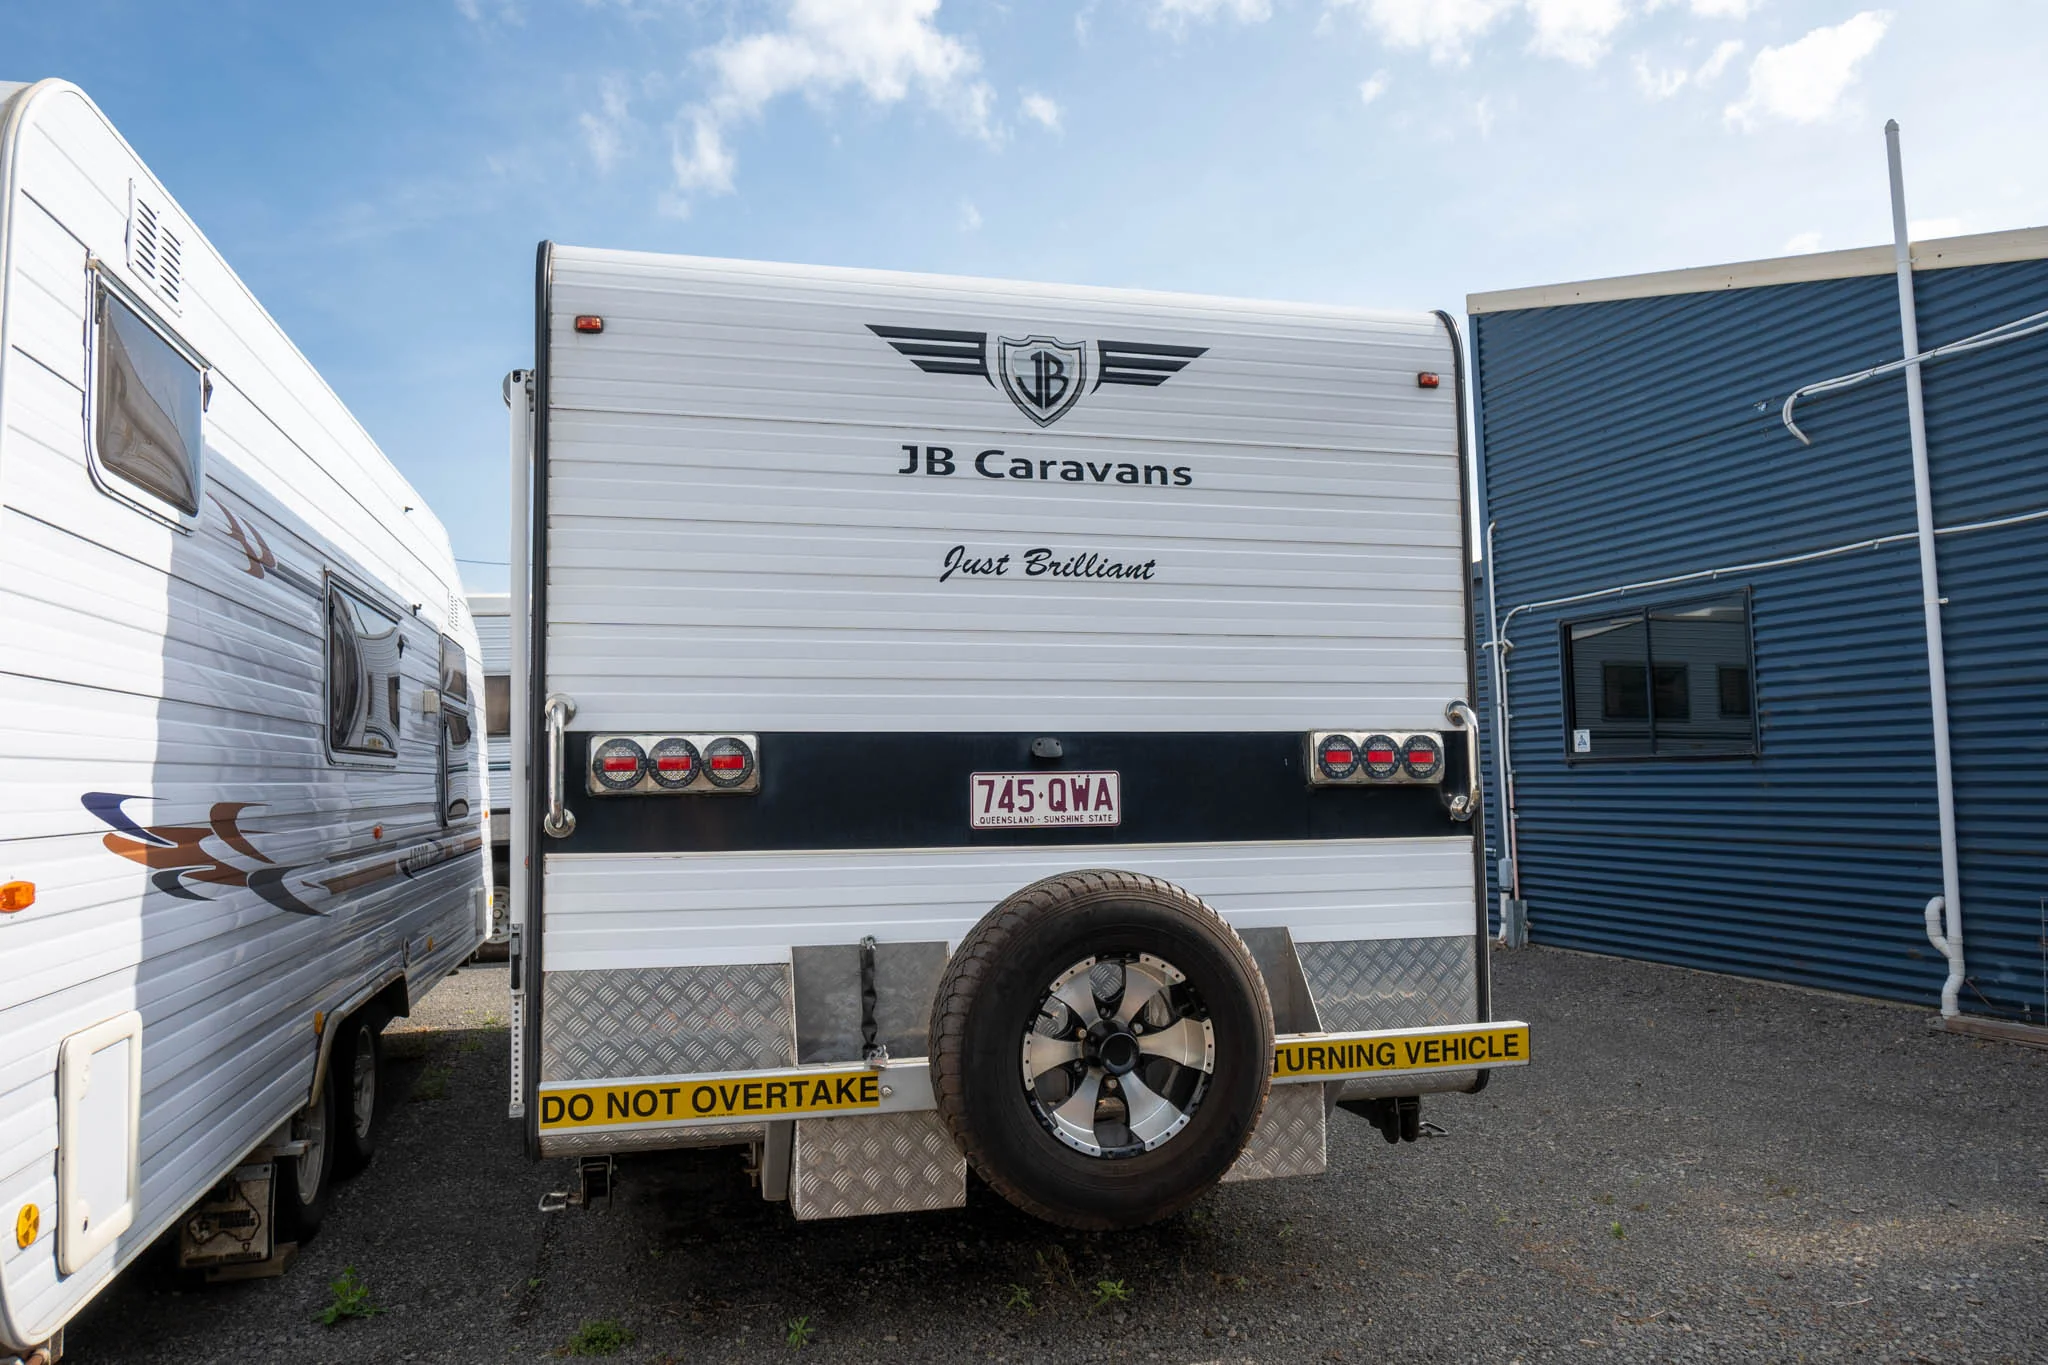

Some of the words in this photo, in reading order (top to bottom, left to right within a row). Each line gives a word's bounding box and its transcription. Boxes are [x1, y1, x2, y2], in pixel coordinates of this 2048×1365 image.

[898, 444, 956, 476] JB
[974, 448, 1193, 487] Caravans
[939, 544, 1010, 584] Just
[1023, 547, 1156, 581] Brilliant
[979, 814, 1036, 825] QUEENSLAND
[1043, 814, 1085, 824] SUNSHINE
[1088, 813, 1113, 823] STATE
[1404, 1033, 1520, 1065] VEHICLE
[541, 1093, 595, 1124] DO
[606, 1087, 681, 1119] NOT
[690, 1075, 880, 1113] OVERTAKE
